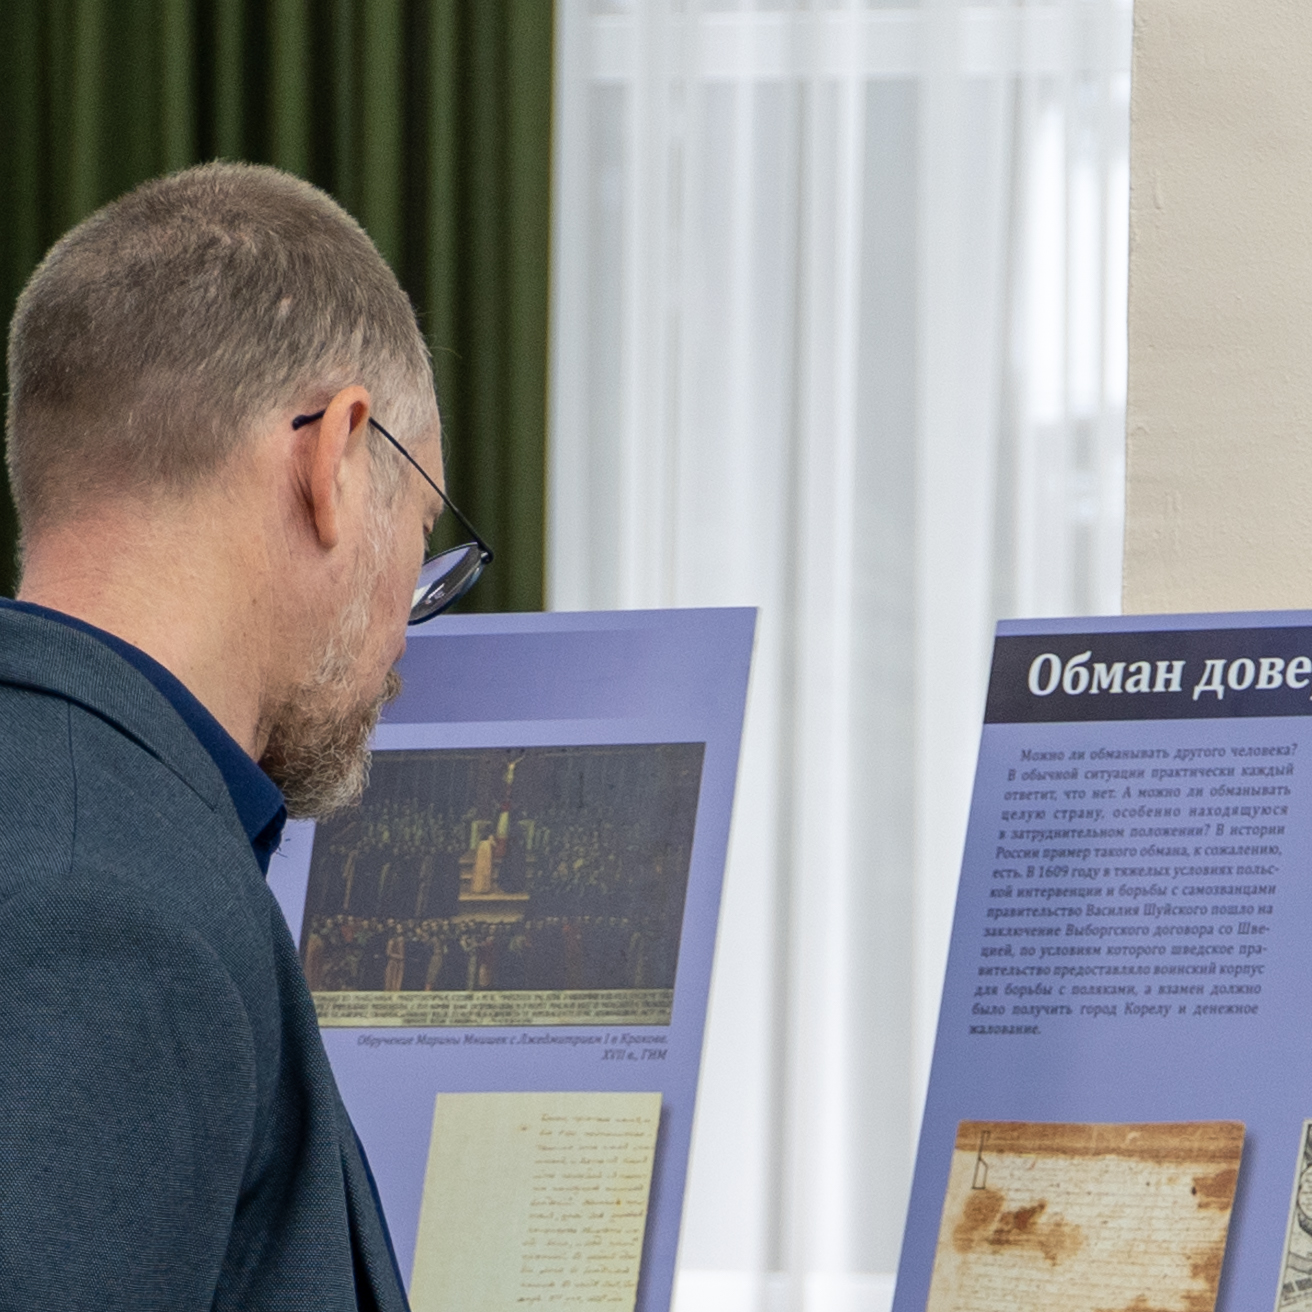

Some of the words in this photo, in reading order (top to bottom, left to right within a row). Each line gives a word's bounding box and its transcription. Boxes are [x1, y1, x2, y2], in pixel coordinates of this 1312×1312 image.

[1027, 650, 1185, 696] Обман
[1019, 748, 1064, 761] Можно
[1089, 747, 1169, 760] обманывать
[1172, 747, 1226, 761] другого
[1230, 742, 1297, 756] человека?
